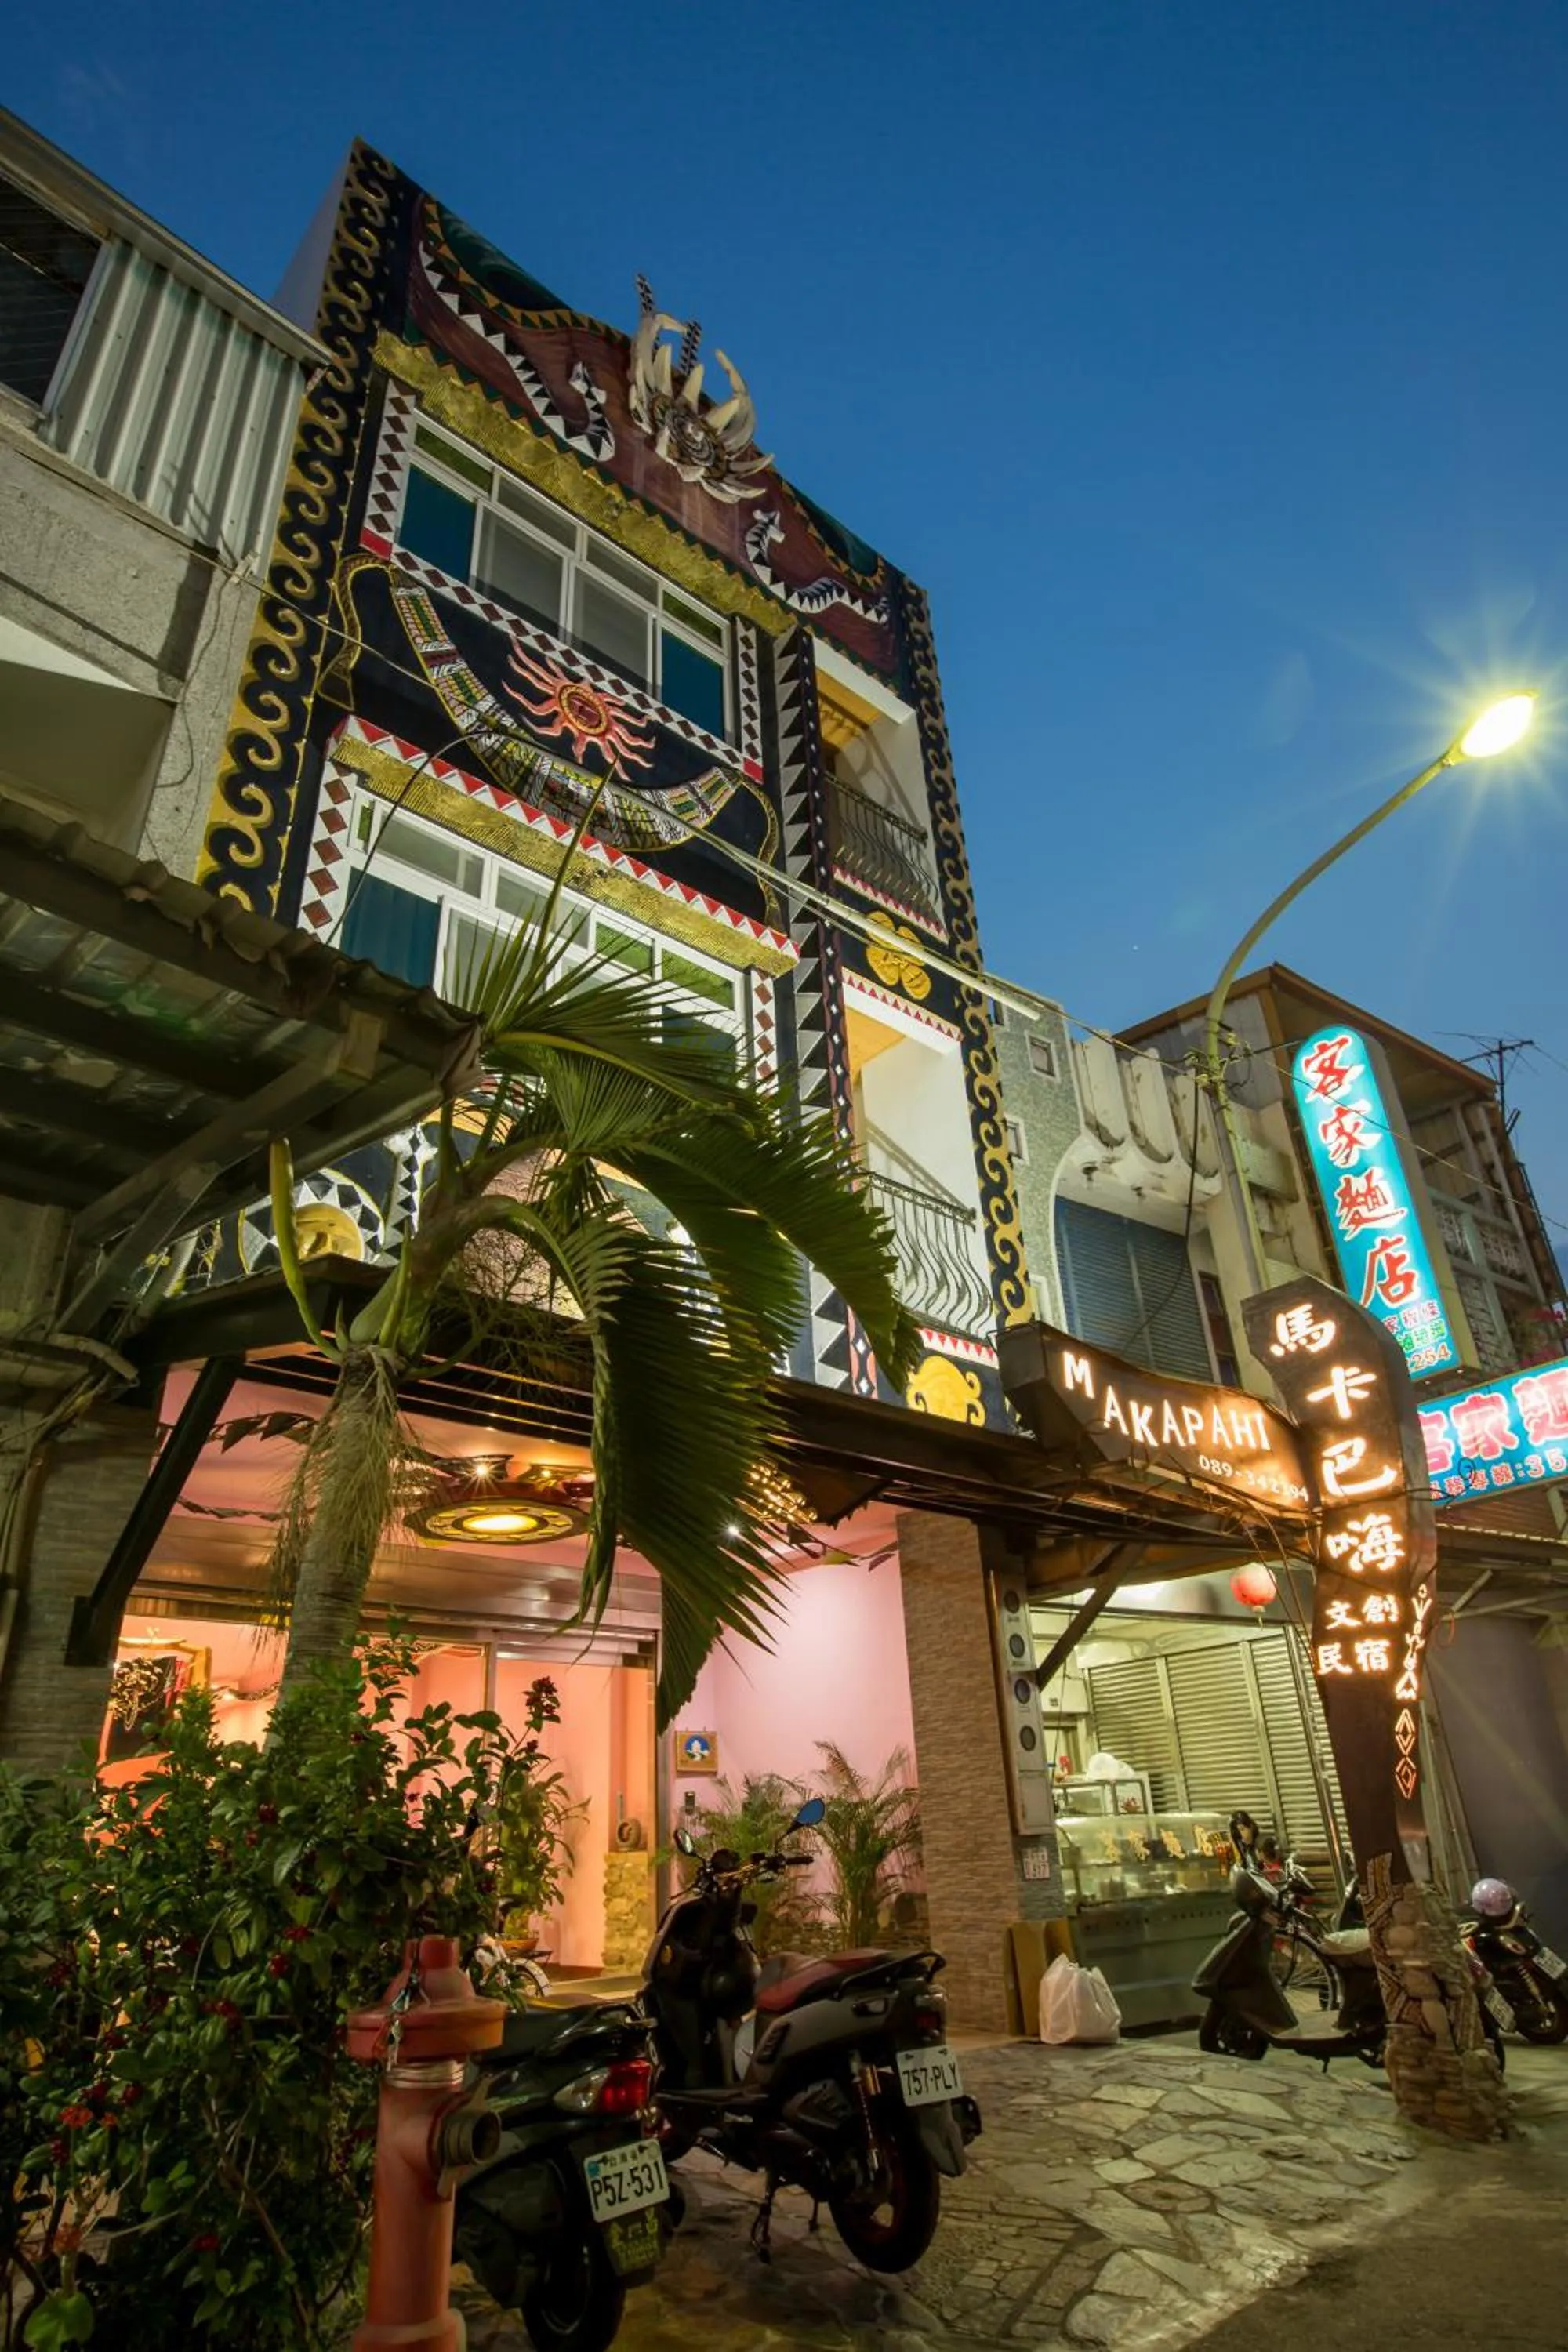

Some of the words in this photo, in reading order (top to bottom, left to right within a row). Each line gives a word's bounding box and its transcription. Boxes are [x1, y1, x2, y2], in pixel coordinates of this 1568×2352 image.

[1302, 1035, 1419, 1308] 客家麵店
[1063, 1350, 1272, 1450] MAKAPAHI
[1269, 1304, 1406, 1570] 馬卡巴嗨
[1324, 1594, 1399, 1628] 文創
[1318, 1639, 1390, 1675] 民宿
[902, 2063, 957, 2096] 757-PLY
[590, 2160, 664, 2212] P5Z-531
